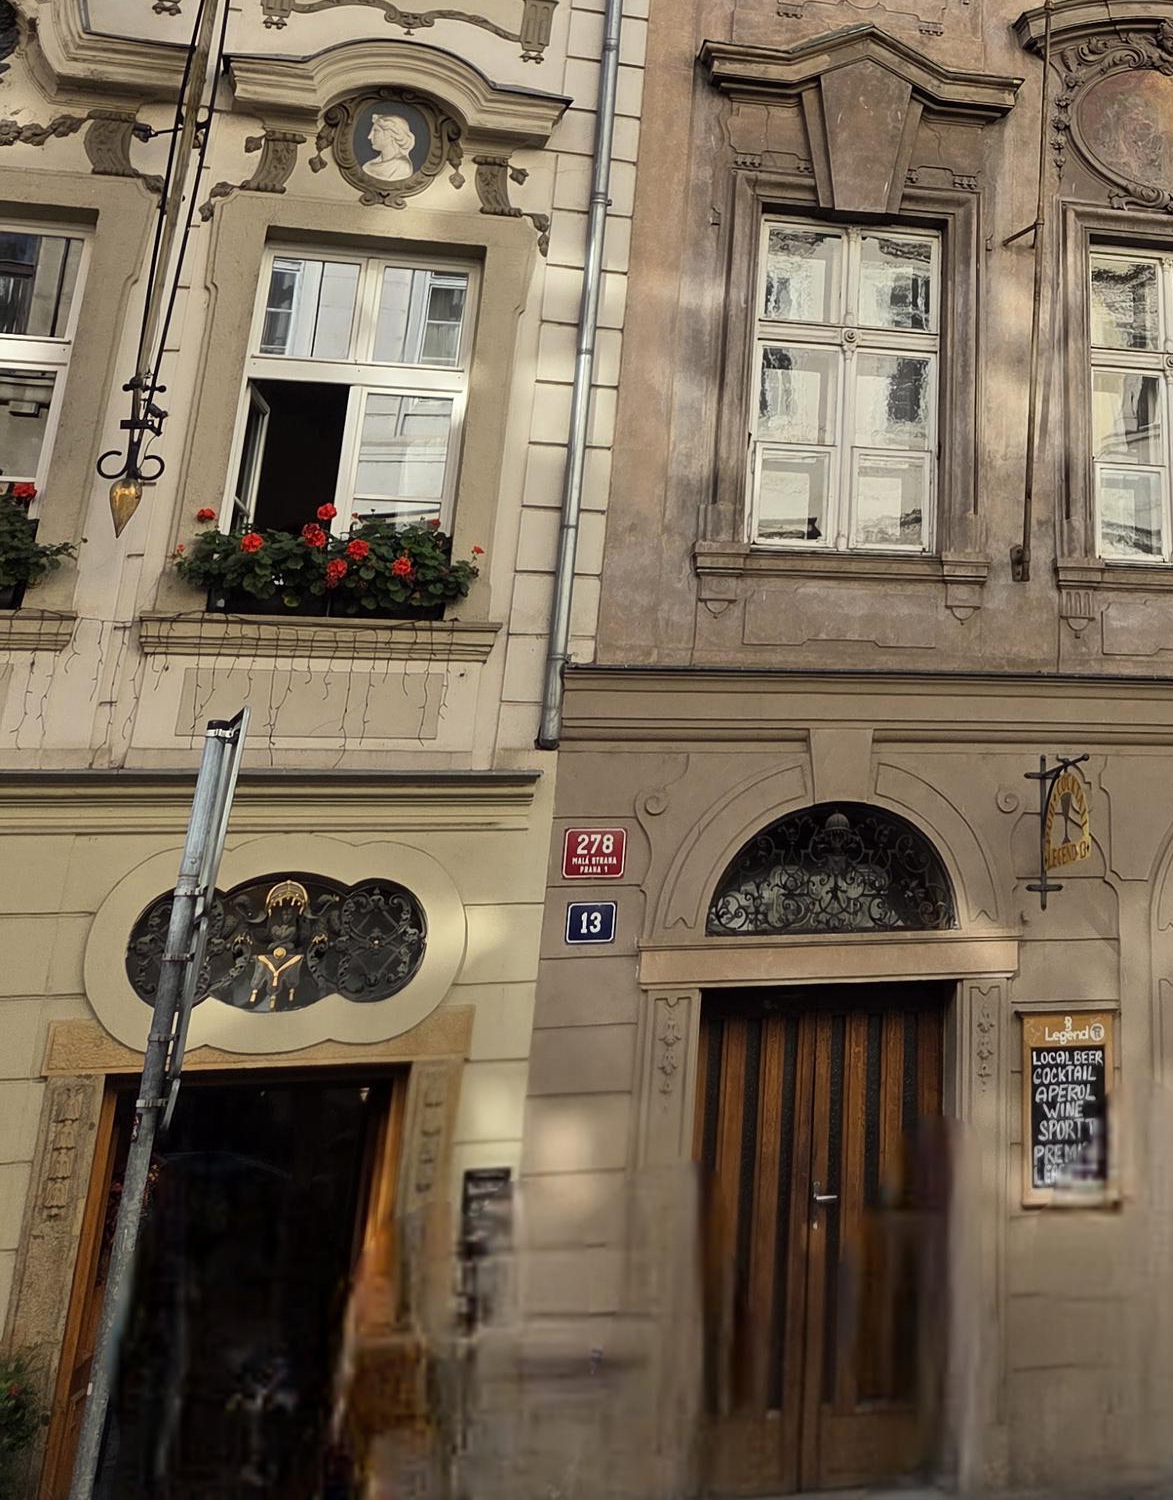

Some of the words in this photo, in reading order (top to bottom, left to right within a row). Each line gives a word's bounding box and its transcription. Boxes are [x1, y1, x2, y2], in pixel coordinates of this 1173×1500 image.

[577, 834, 614, 855] 278
[572, 855, 590, 865] MALÁ
[579, 865, 602, 874] PRAHA
[580, 911, 602, 934] 13
[1044, 1025, 1089, 1045] Legend
[1032, 1051, 1072, 1065] LOCAL
[1073, 1050, 1104, 1067] BEER
[1033, 1066, 1097, 1084] COCKTAIL
[1035, 1083, 1097, 1102] APEROL
[1042, 1100, 1084, 1119] WINE
[1037, 1118, 1085, 1141] SPORT
